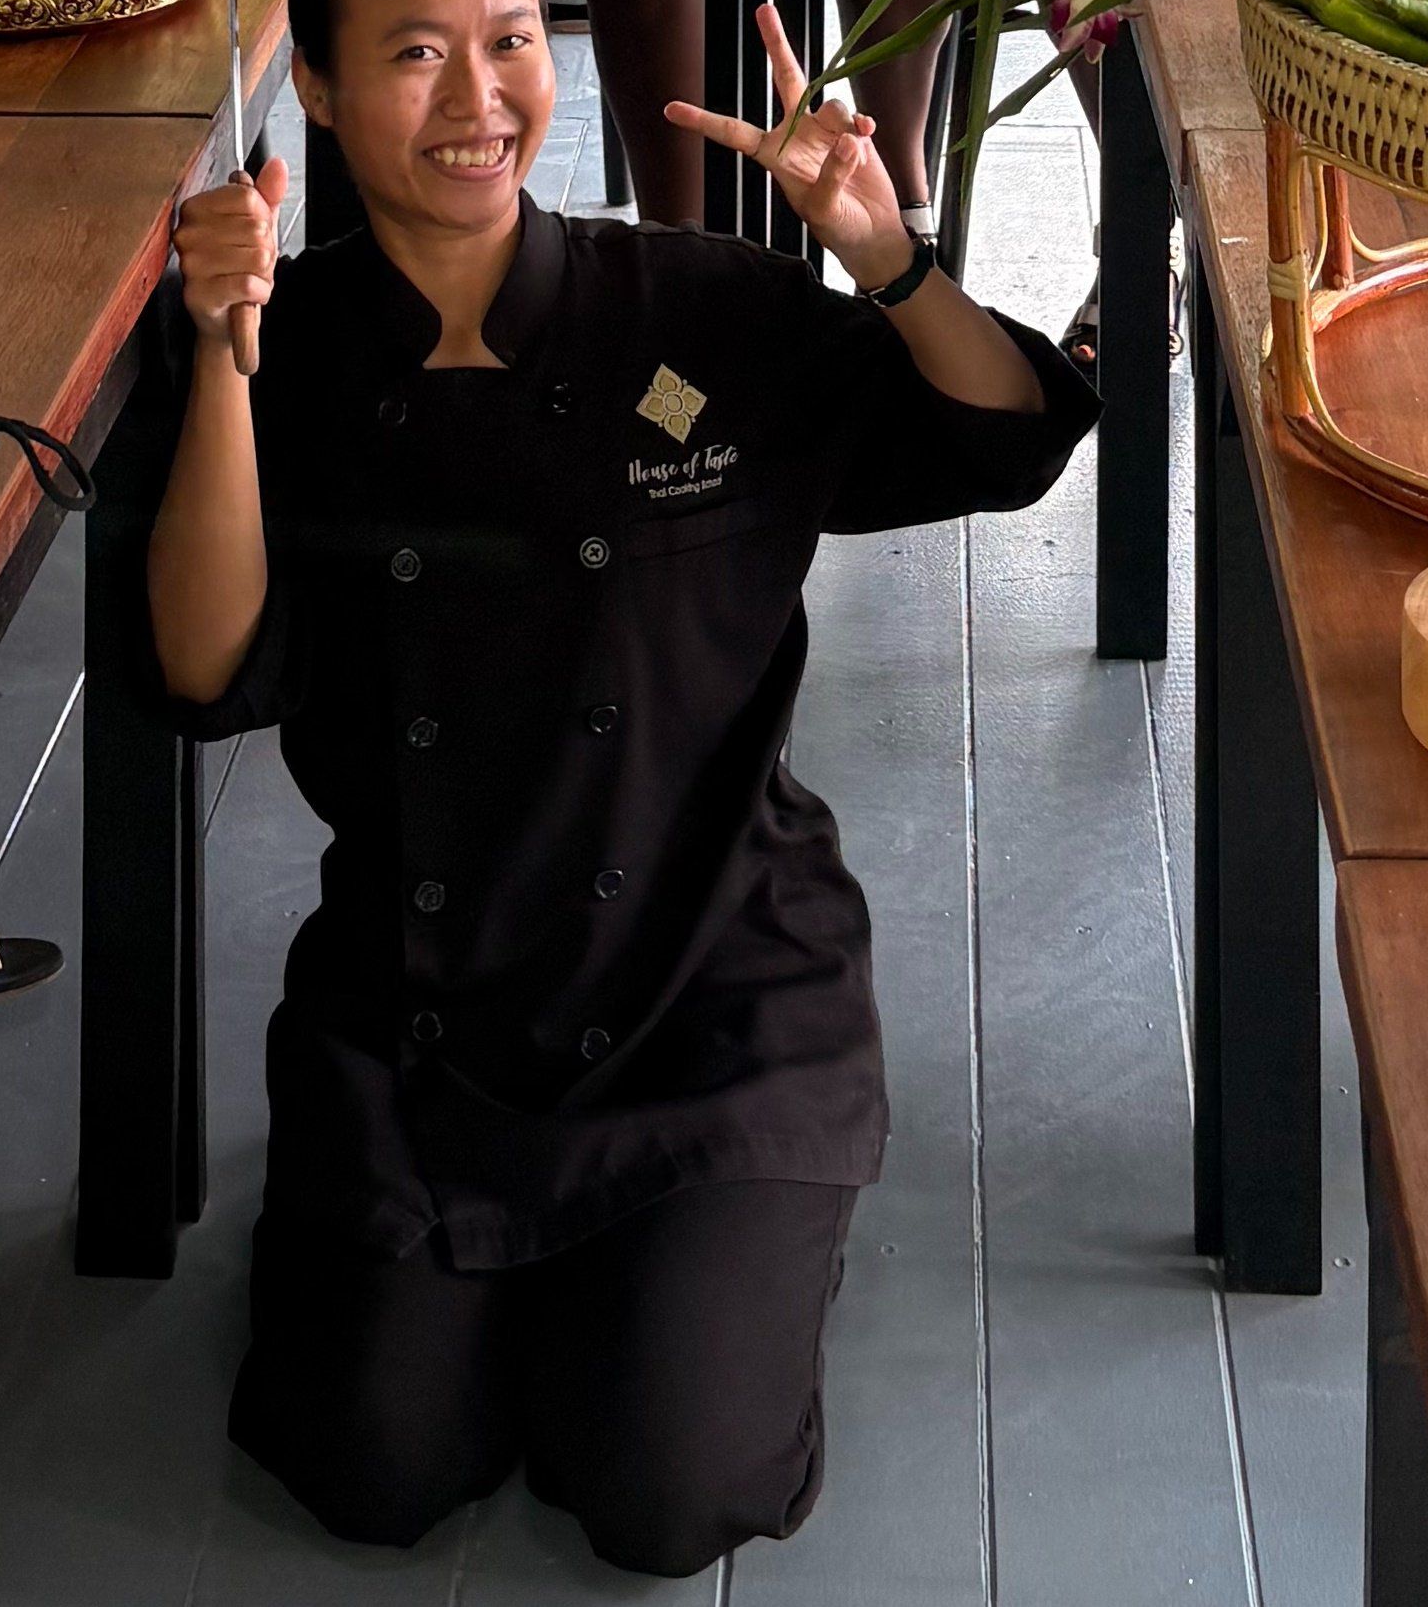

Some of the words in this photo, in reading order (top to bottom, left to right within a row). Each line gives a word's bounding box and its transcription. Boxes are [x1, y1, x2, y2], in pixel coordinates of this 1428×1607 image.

[628, 458, 679, 485] House
[682, 451, 700, 479] of
[704, 444, 739, 471] Taste
